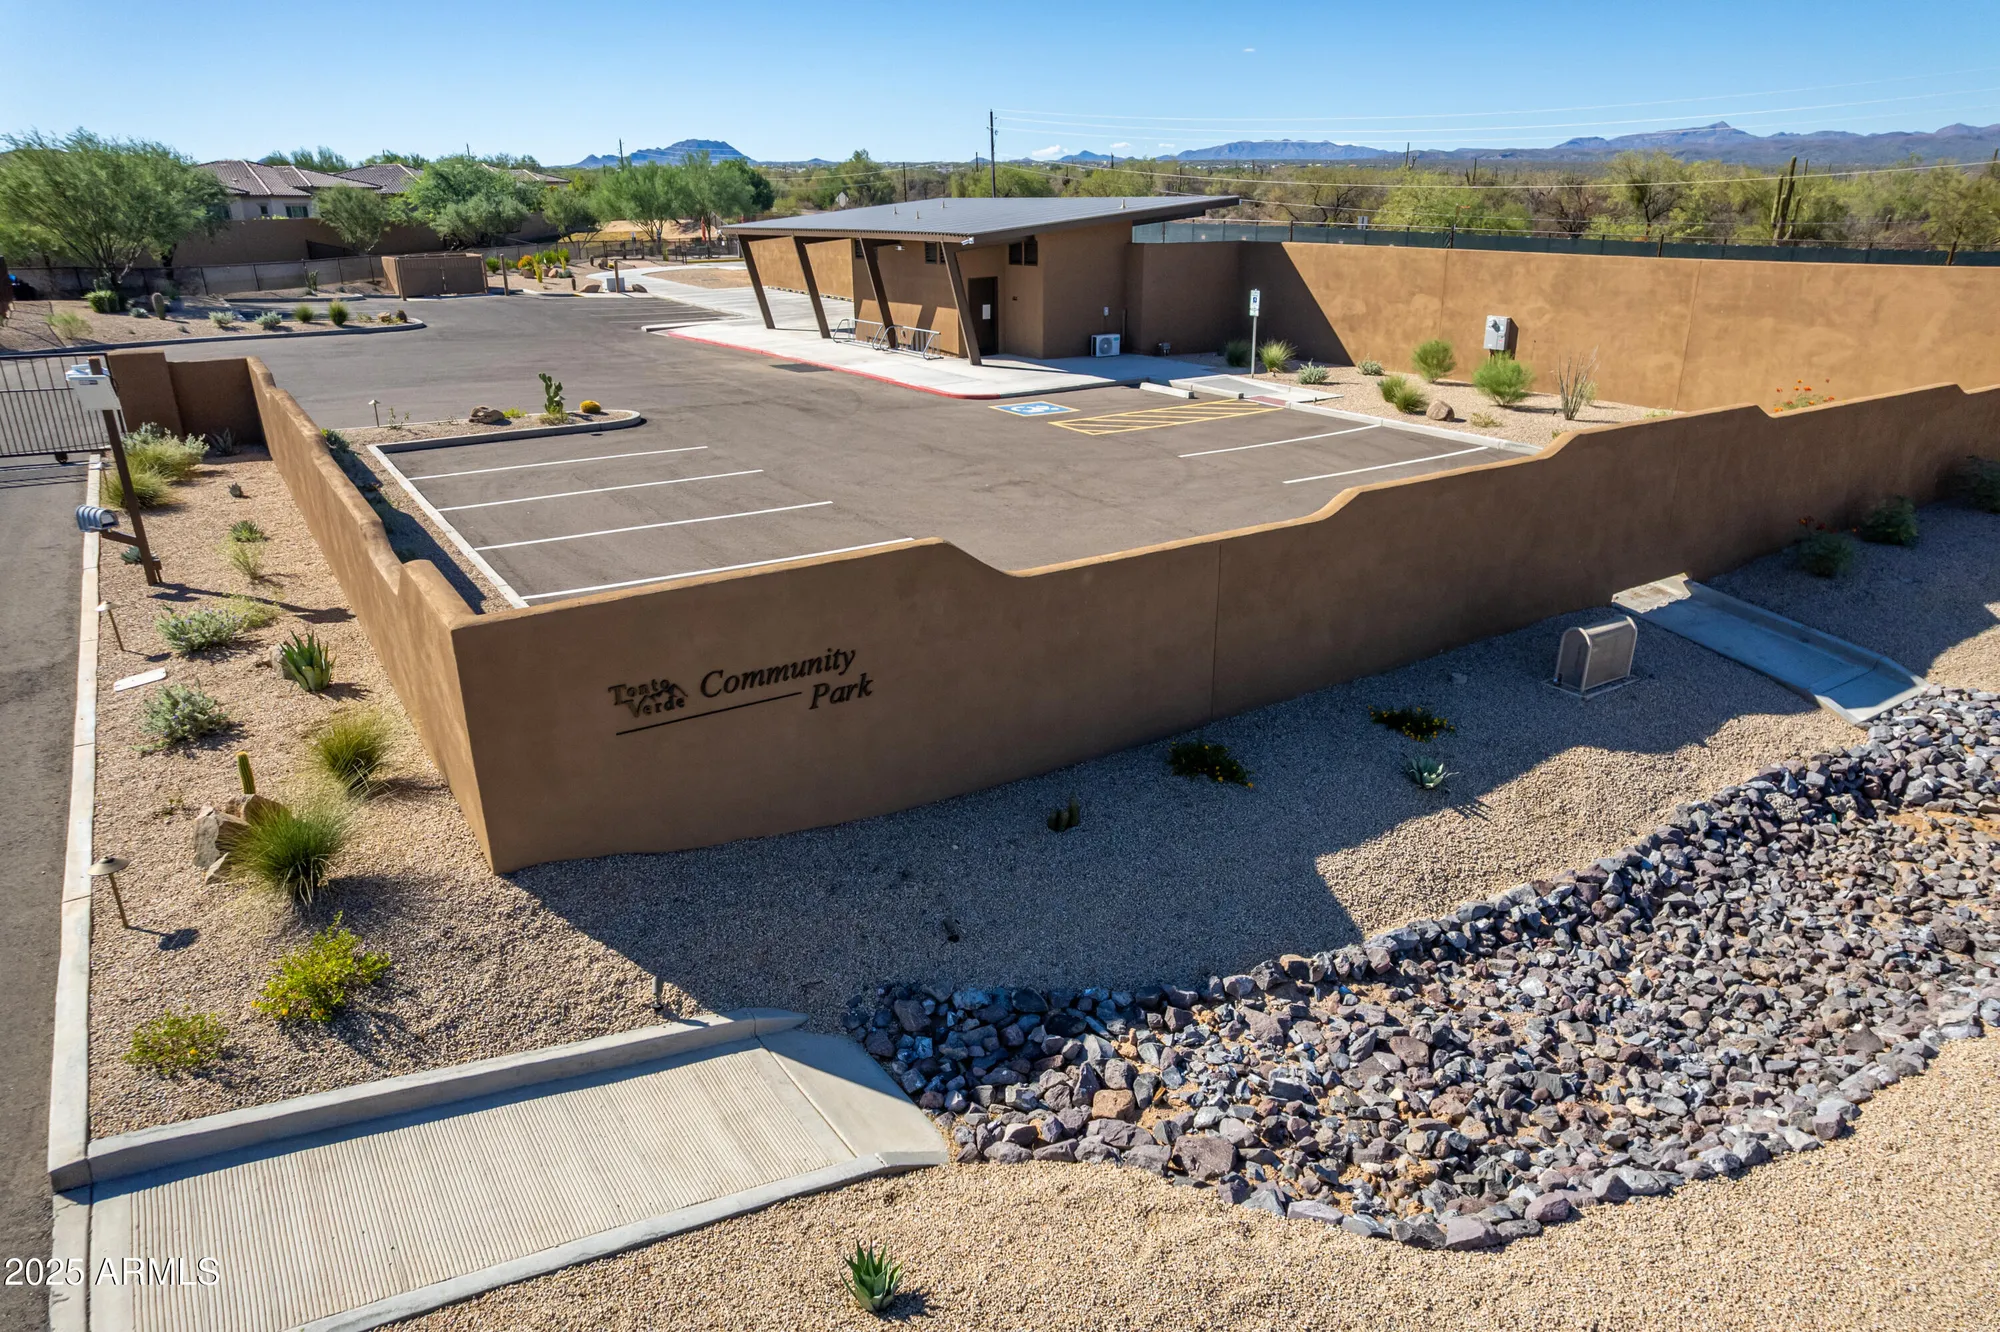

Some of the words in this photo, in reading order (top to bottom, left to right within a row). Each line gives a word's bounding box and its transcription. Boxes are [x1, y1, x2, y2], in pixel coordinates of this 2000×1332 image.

[700, 648, 857, 698] Community
[608, 679, 671, 706] Tonto
[622, 694, 686, 718] Verde
[809, 672, 874, 710] Park
